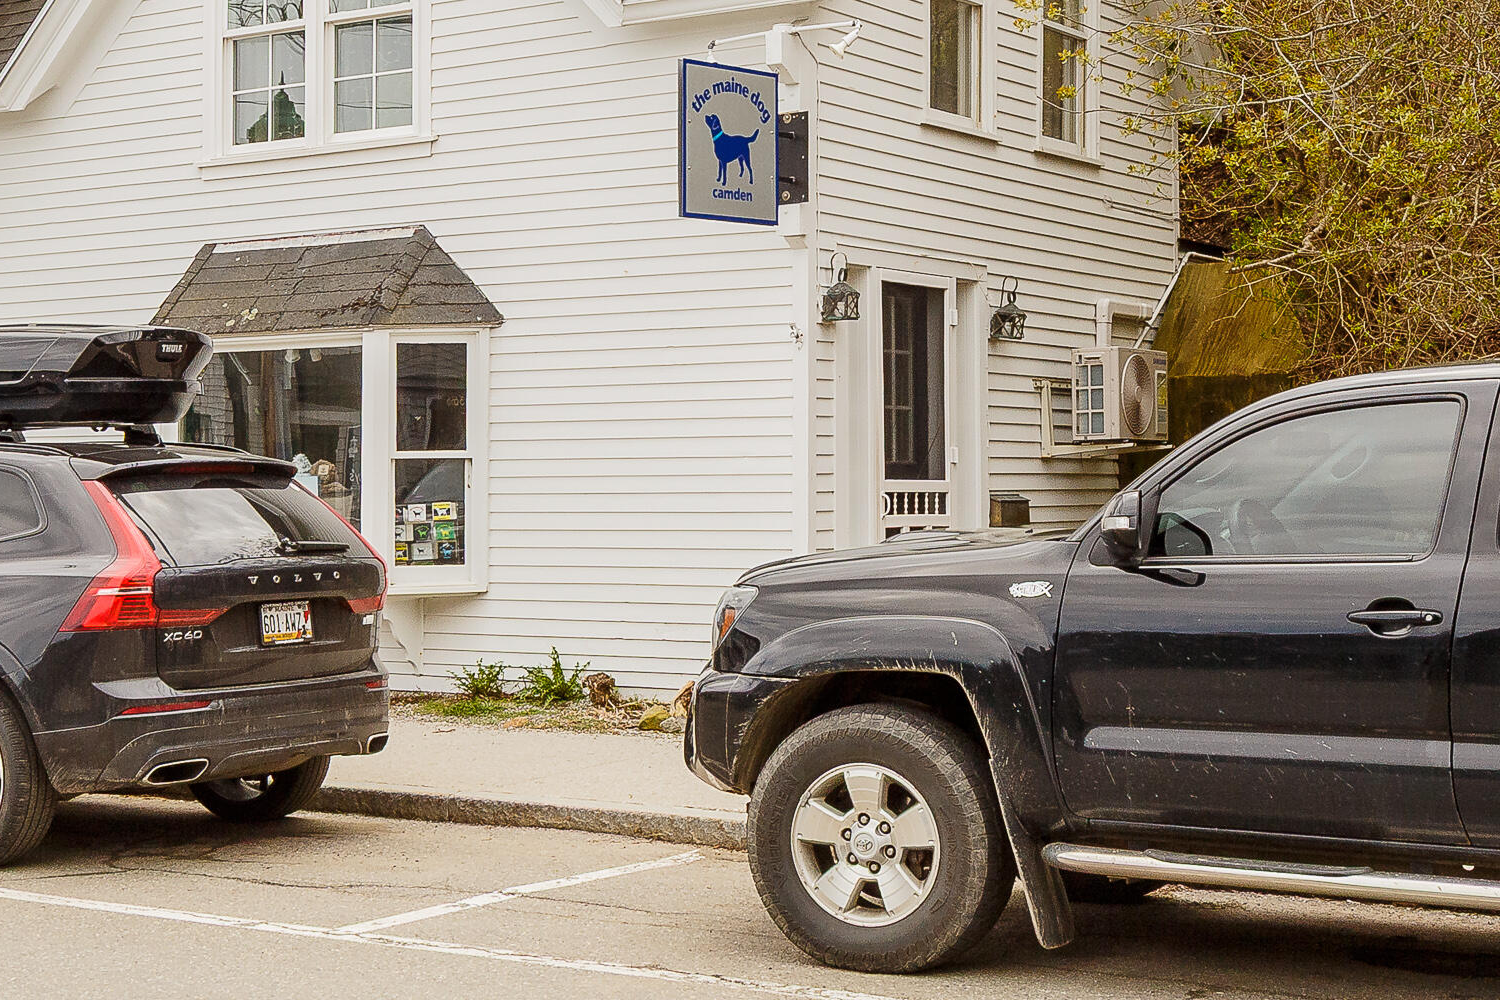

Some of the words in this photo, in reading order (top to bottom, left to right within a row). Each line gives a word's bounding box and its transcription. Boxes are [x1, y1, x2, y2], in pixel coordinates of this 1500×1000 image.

[691, 88, 712, 113] the
[712, 76, 750, 98] maine
[750, 91, 771, 124] dog
[712, 187, 753, 201] camden
[161, 344, 183, 353] THULE
[248, 570, 340, 585] VOLVO
[163, 630, 203, 643] XC60
